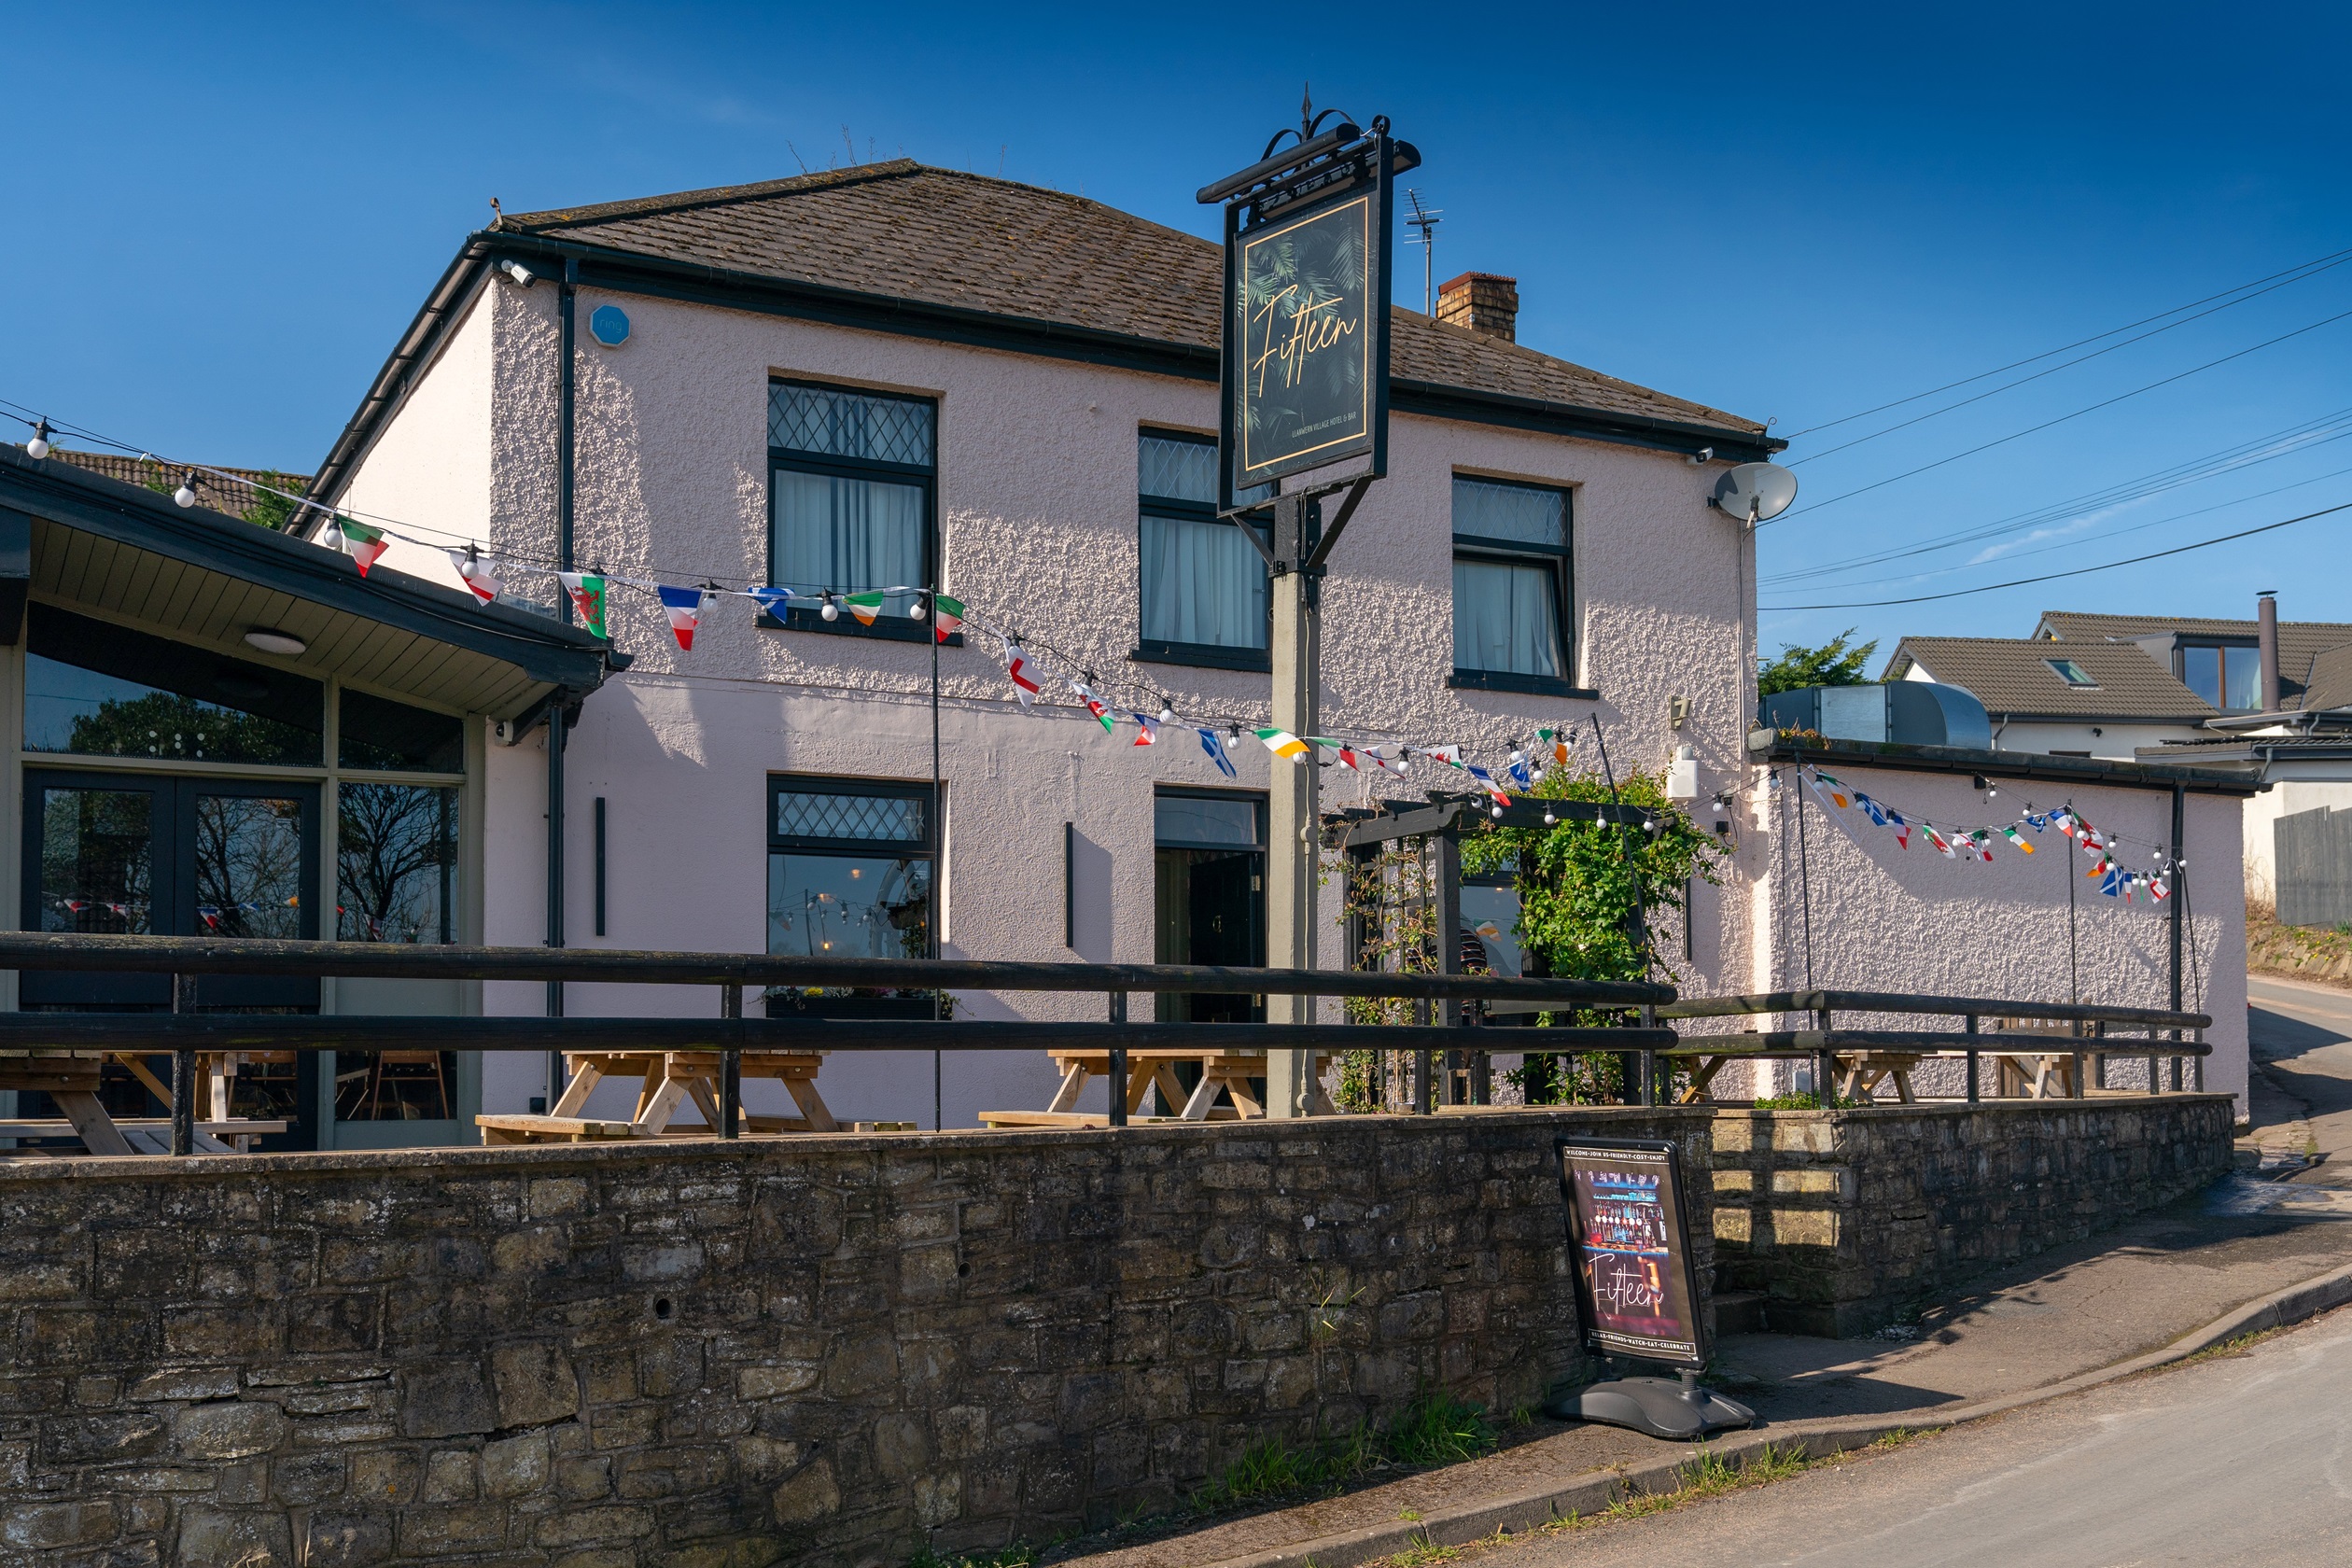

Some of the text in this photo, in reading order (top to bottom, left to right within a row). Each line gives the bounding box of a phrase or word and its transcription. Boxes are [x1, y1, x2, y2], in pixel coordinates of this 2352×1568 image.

[599, 318, 623, 334] ring
[1253, 284, 1357, 398] Fifteen
[1292, 424, 1313, 438] LLANWERN
[1313, 419, 1330, 431] VILLAGE
[1330, 415, 1342, 427] HOTEL
[1348, 411, 1357, 421] BAR
[1588, 1253, 1665, 1315] Fifteen
